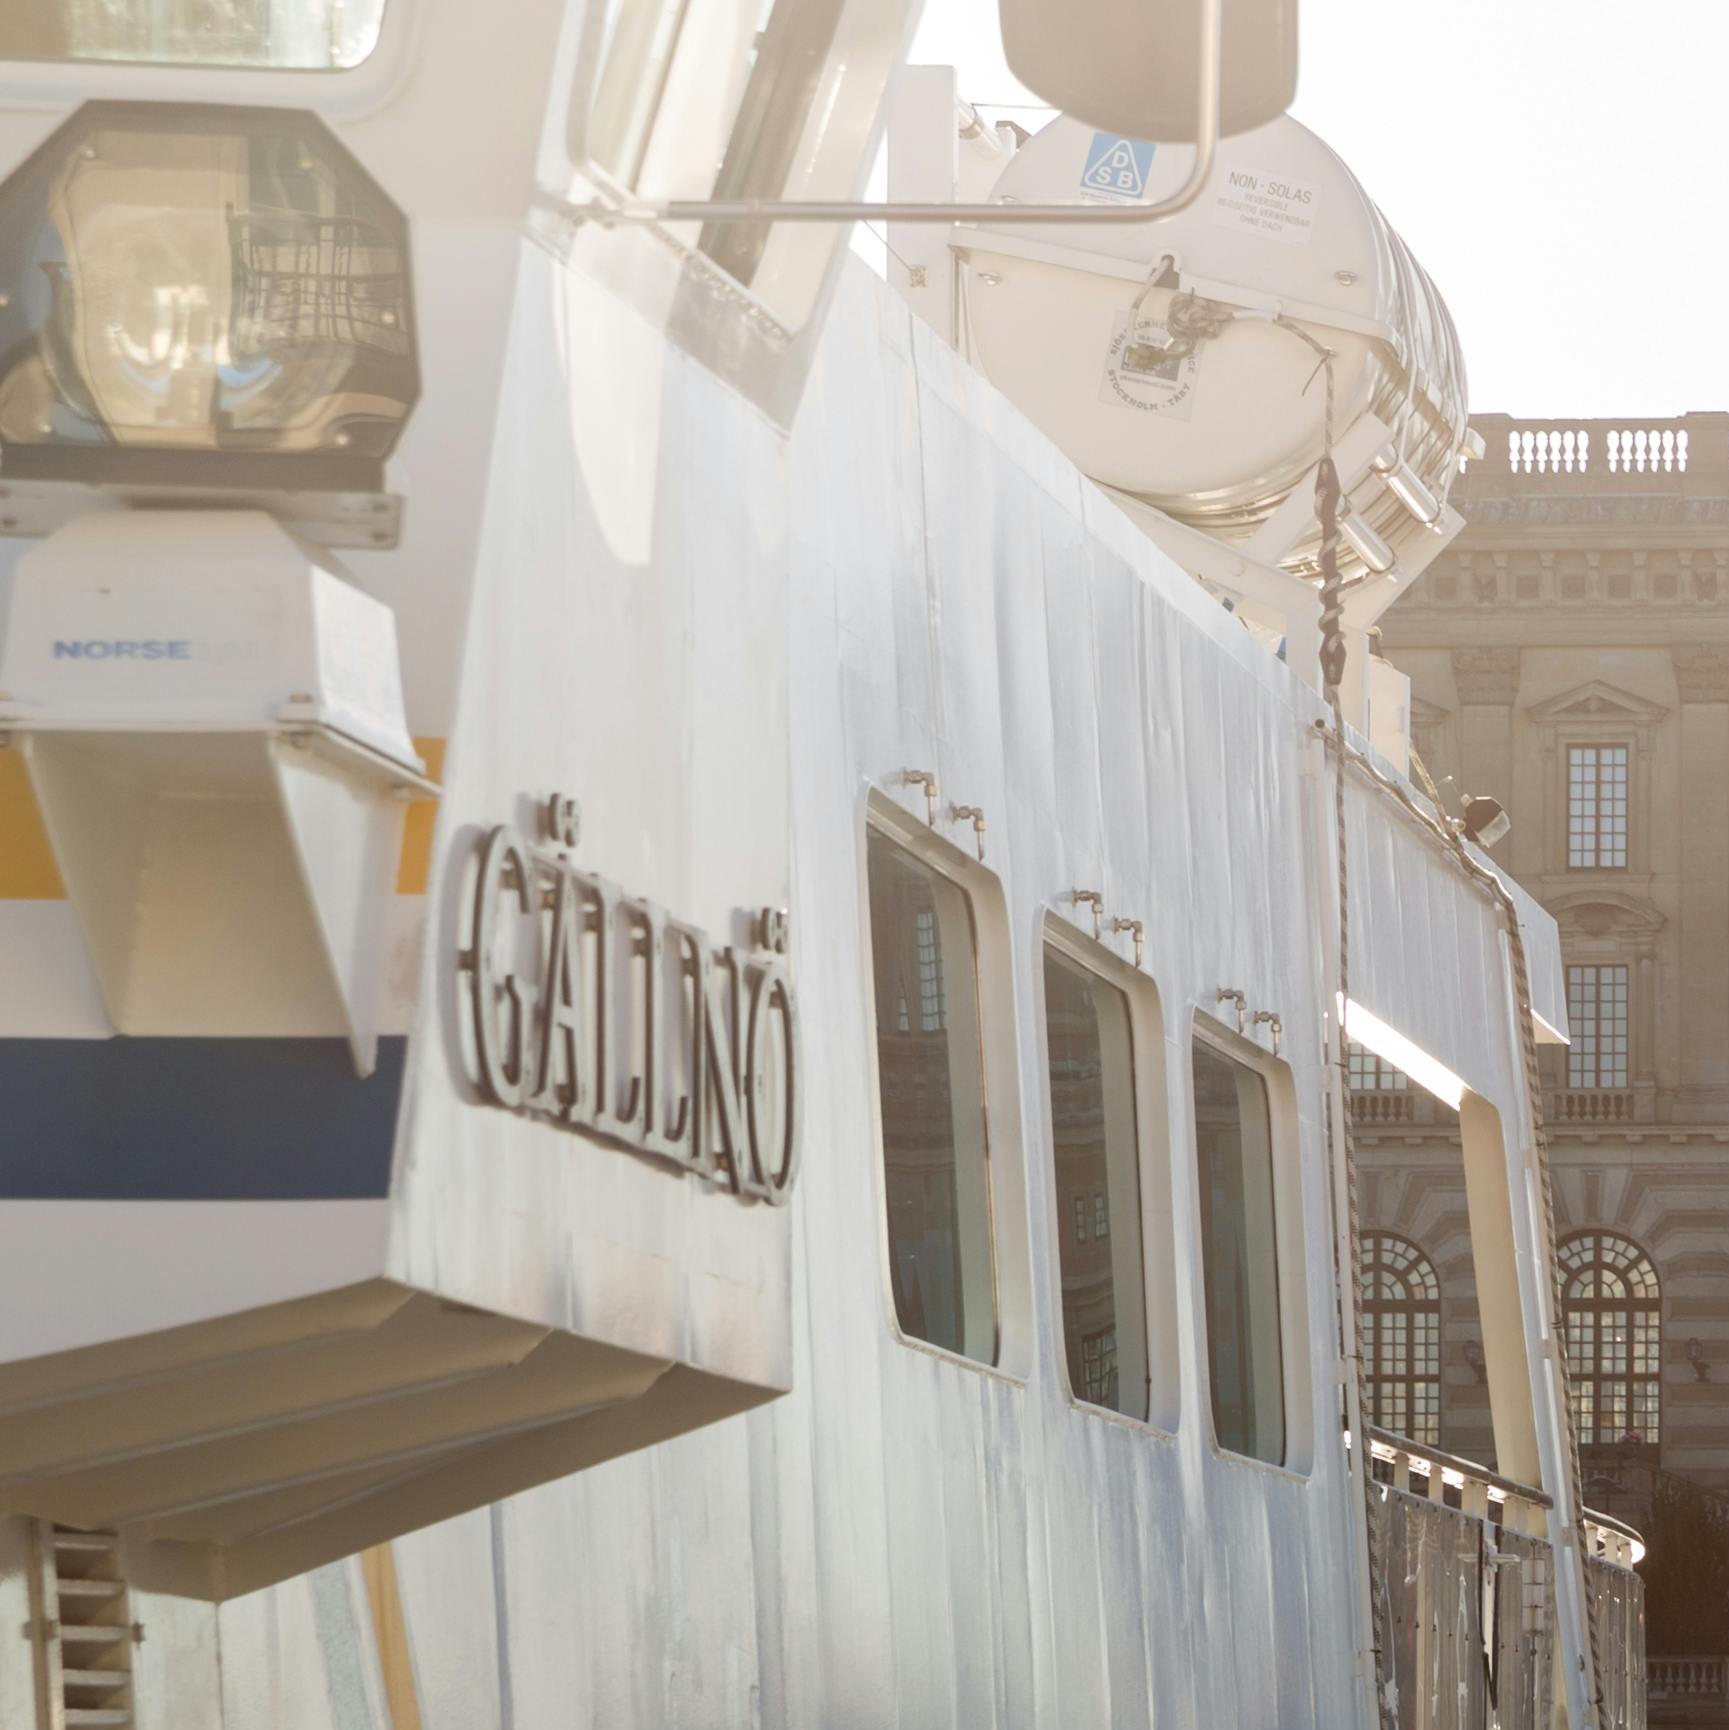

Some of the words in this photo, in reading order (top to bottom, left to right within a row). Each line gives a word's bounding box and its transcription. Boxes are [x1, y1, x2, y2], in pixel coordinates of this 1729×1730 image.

[1229, 172, 1258, 190] NON
[1267, 181, 1313, 205] SOLAS
[470, 792, 799, 1207] GÄLLNÖ
